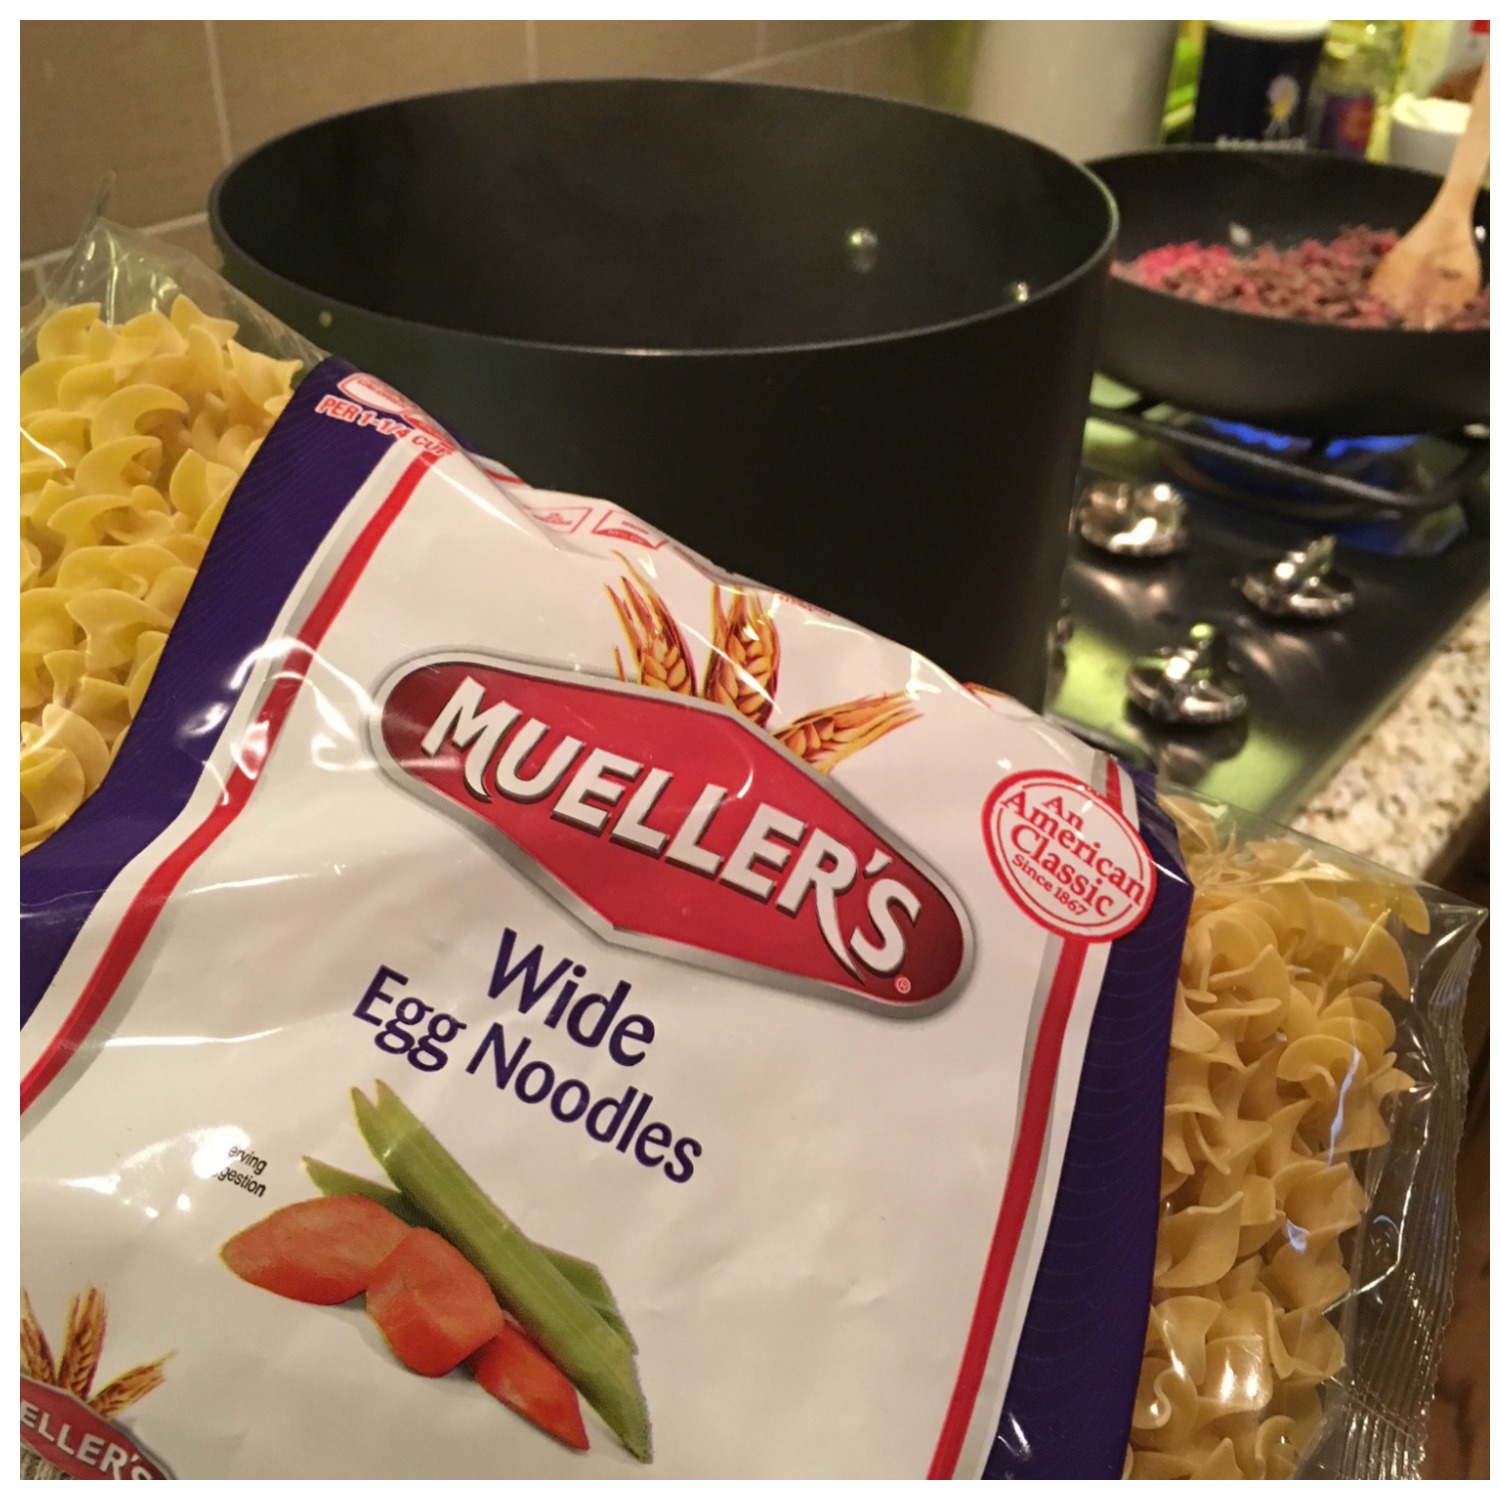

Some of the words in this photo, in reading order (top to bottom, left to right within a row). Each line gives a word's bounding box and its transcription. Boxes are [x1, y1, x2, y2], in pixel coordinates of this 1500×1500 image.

[316, 395, 362, 421] PER
[420, 675, 922, 987] MUELLER'S
[1000, 790, 1147, 906] American
[1042, 796, 1084, 832] An
[1010, 823, 1114, 918] Classic
[1011, 853, 1053, 892] Since
[1053, 886, 1089, 916] 1867
[487, 927, 656, 1067] Wide
[352, 965, 467, 1073] Egg
[465, 1021, 703, 1184] Noodles
[214, 1166, 267, 1198] gestion
[226, 1145, 268, 1176] erving
[20, 1399, 153, 1480] ELLER'
